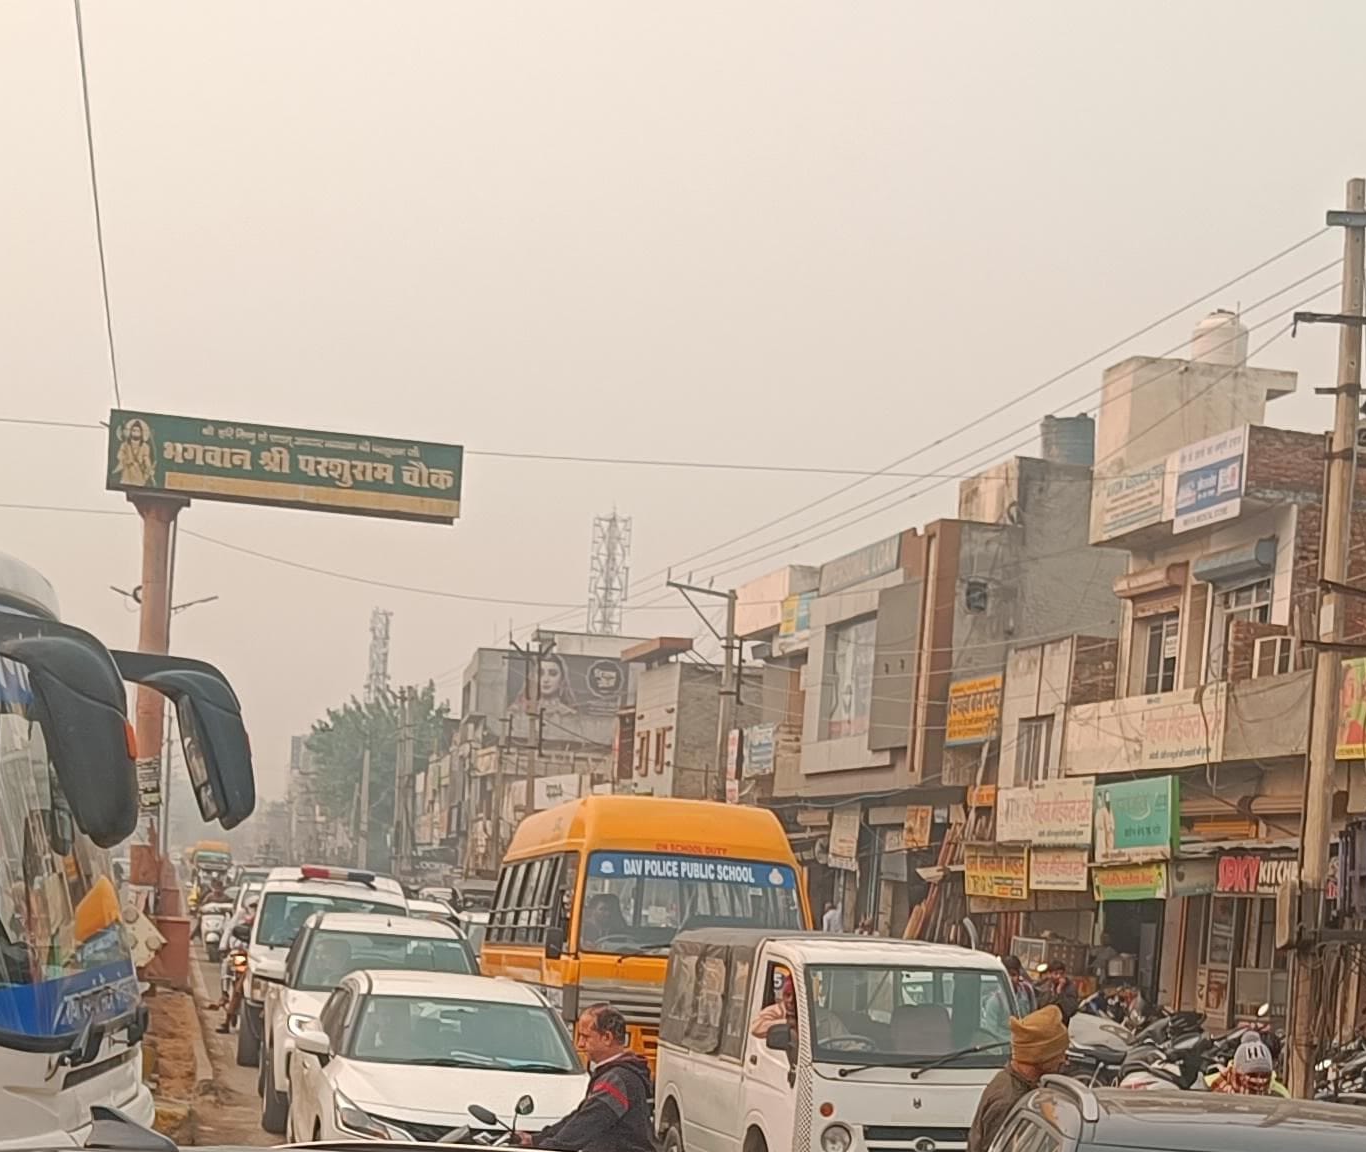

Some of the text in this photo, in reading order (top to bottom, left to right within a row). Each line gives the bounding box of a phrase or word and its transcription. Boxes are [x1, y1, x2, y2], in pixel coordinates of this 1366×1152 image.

[163, 441, 252, 471] भगवान
[259, 446, 291, 475] श्री
[297, 453, 395, 488] परशुराम
[401, 460, 455, 491] चौक
[623, 858, 755, 884] DAV POLICE PUBLIC SCHOOL
[1217, 856, 1261, 893] SPICY
